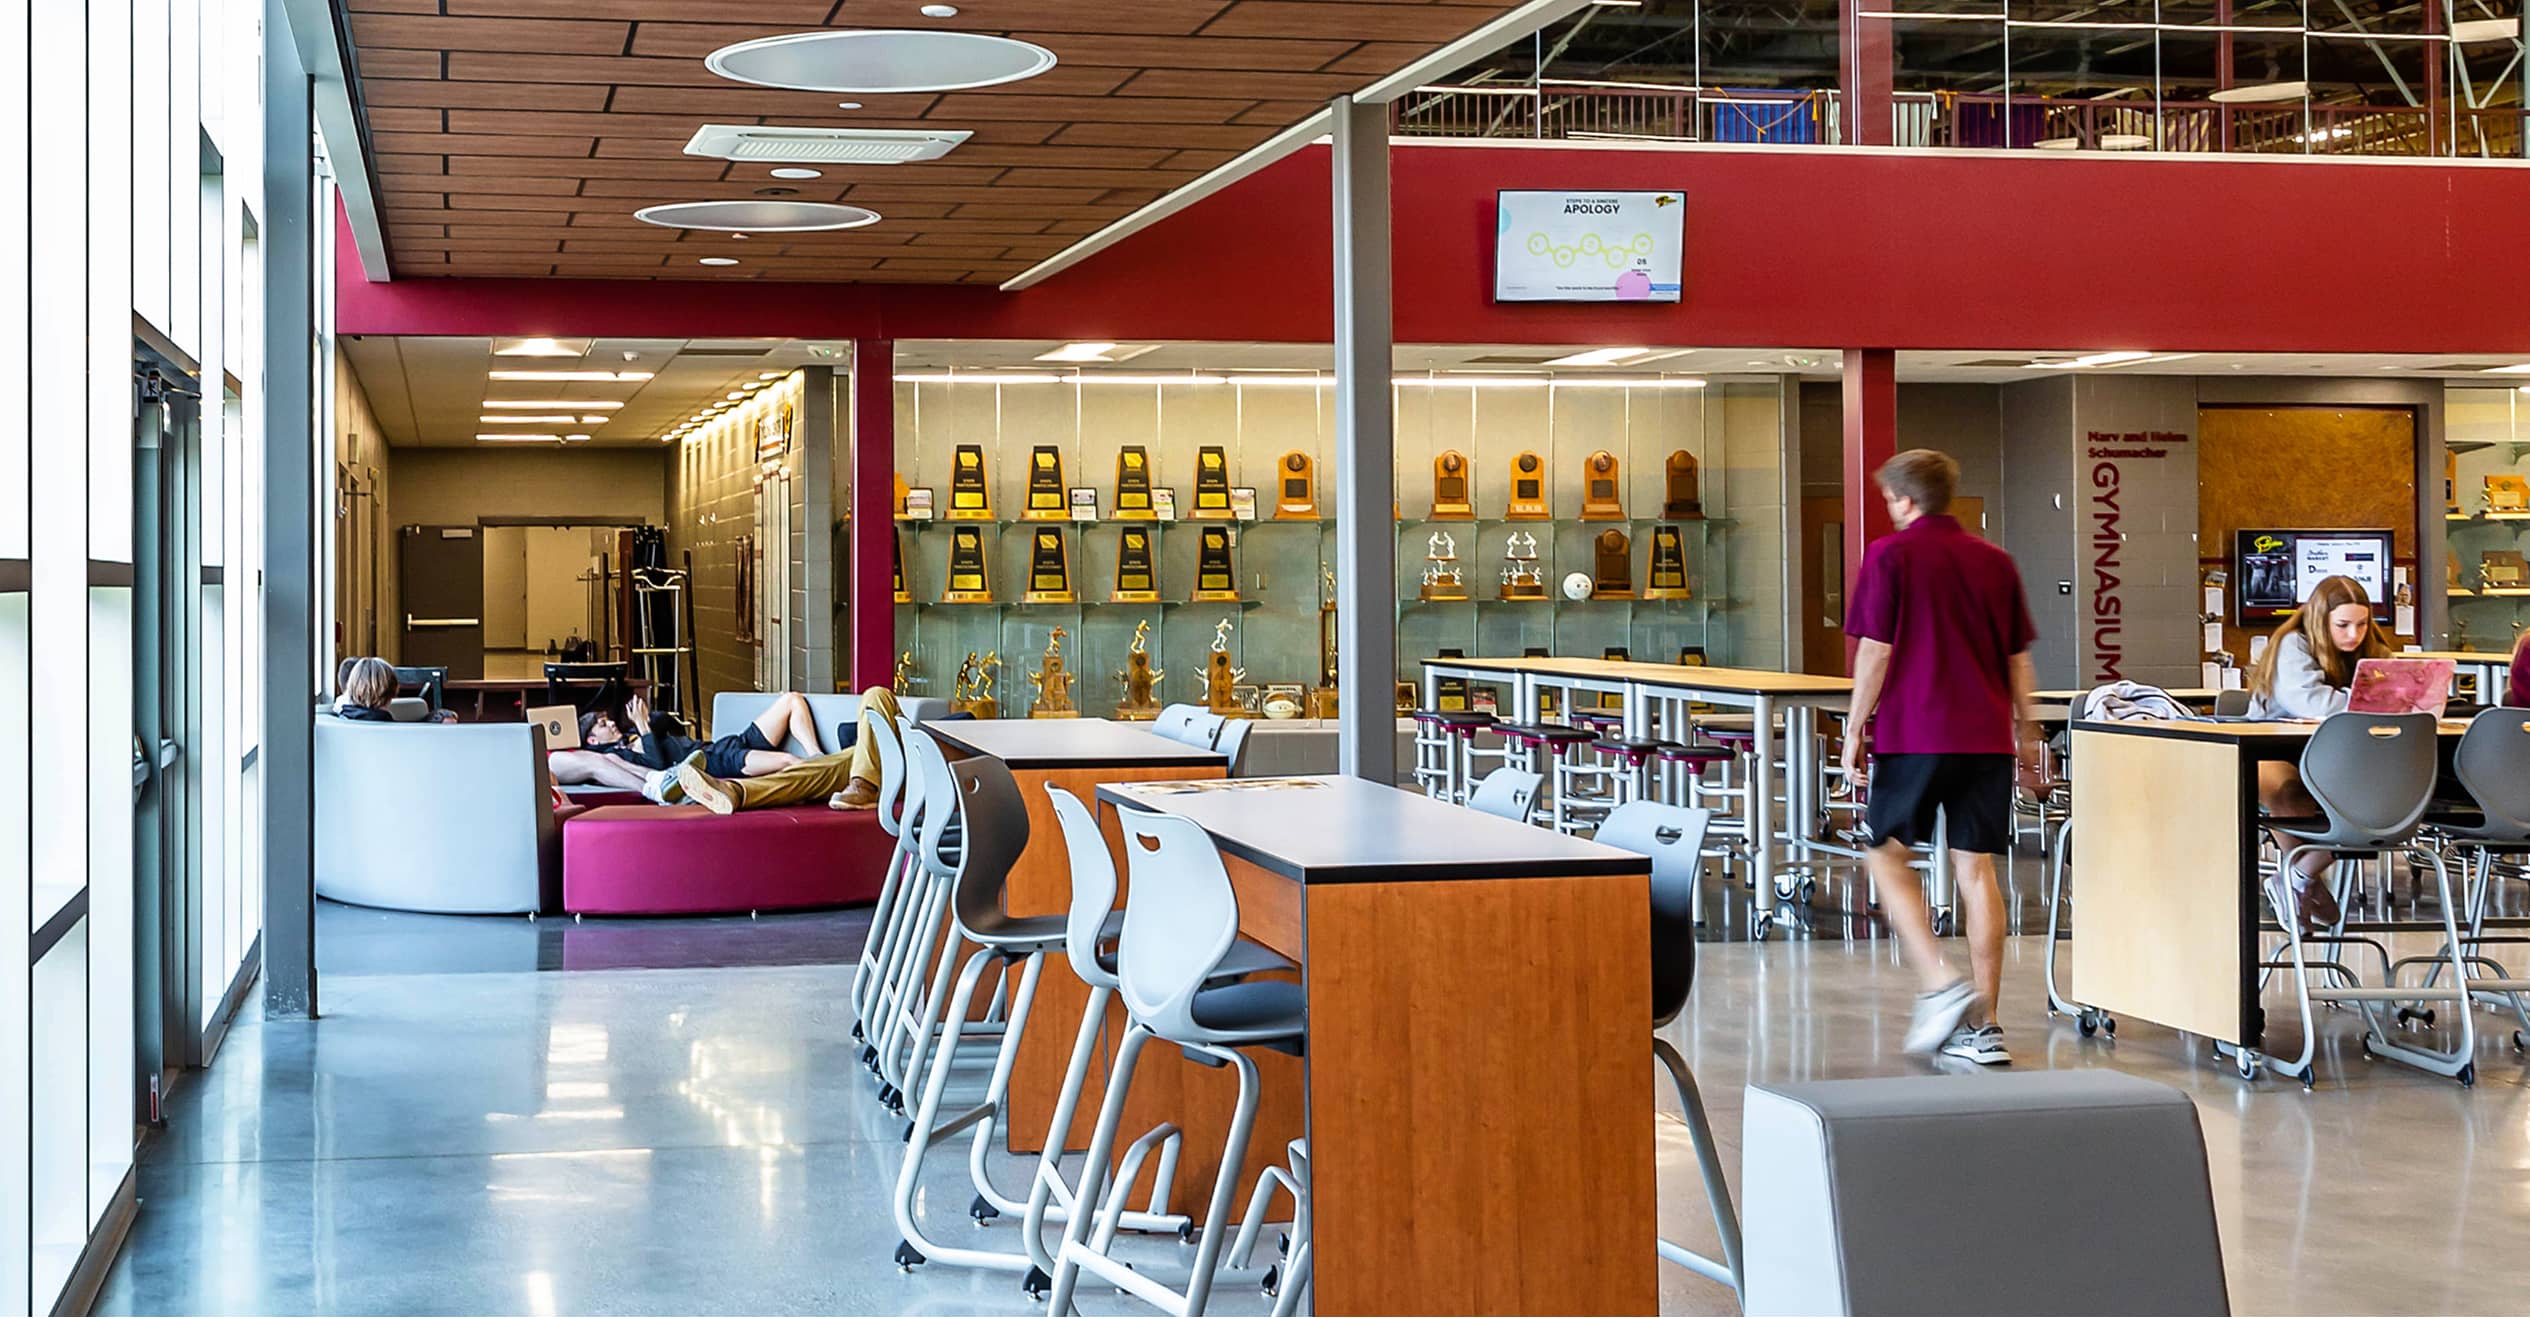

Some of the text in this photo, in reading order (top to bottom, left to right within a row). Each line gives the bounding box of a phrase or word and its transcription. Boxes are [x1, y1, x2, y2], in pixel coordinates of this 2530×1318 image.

[1563, 204, 1620, 215] APOLOGY
[2123, 431, 2147, 442] and
[2087, 447, 2168, 458] Schumacher
[2092, 462, 2121, 681] GYMNASIUM
